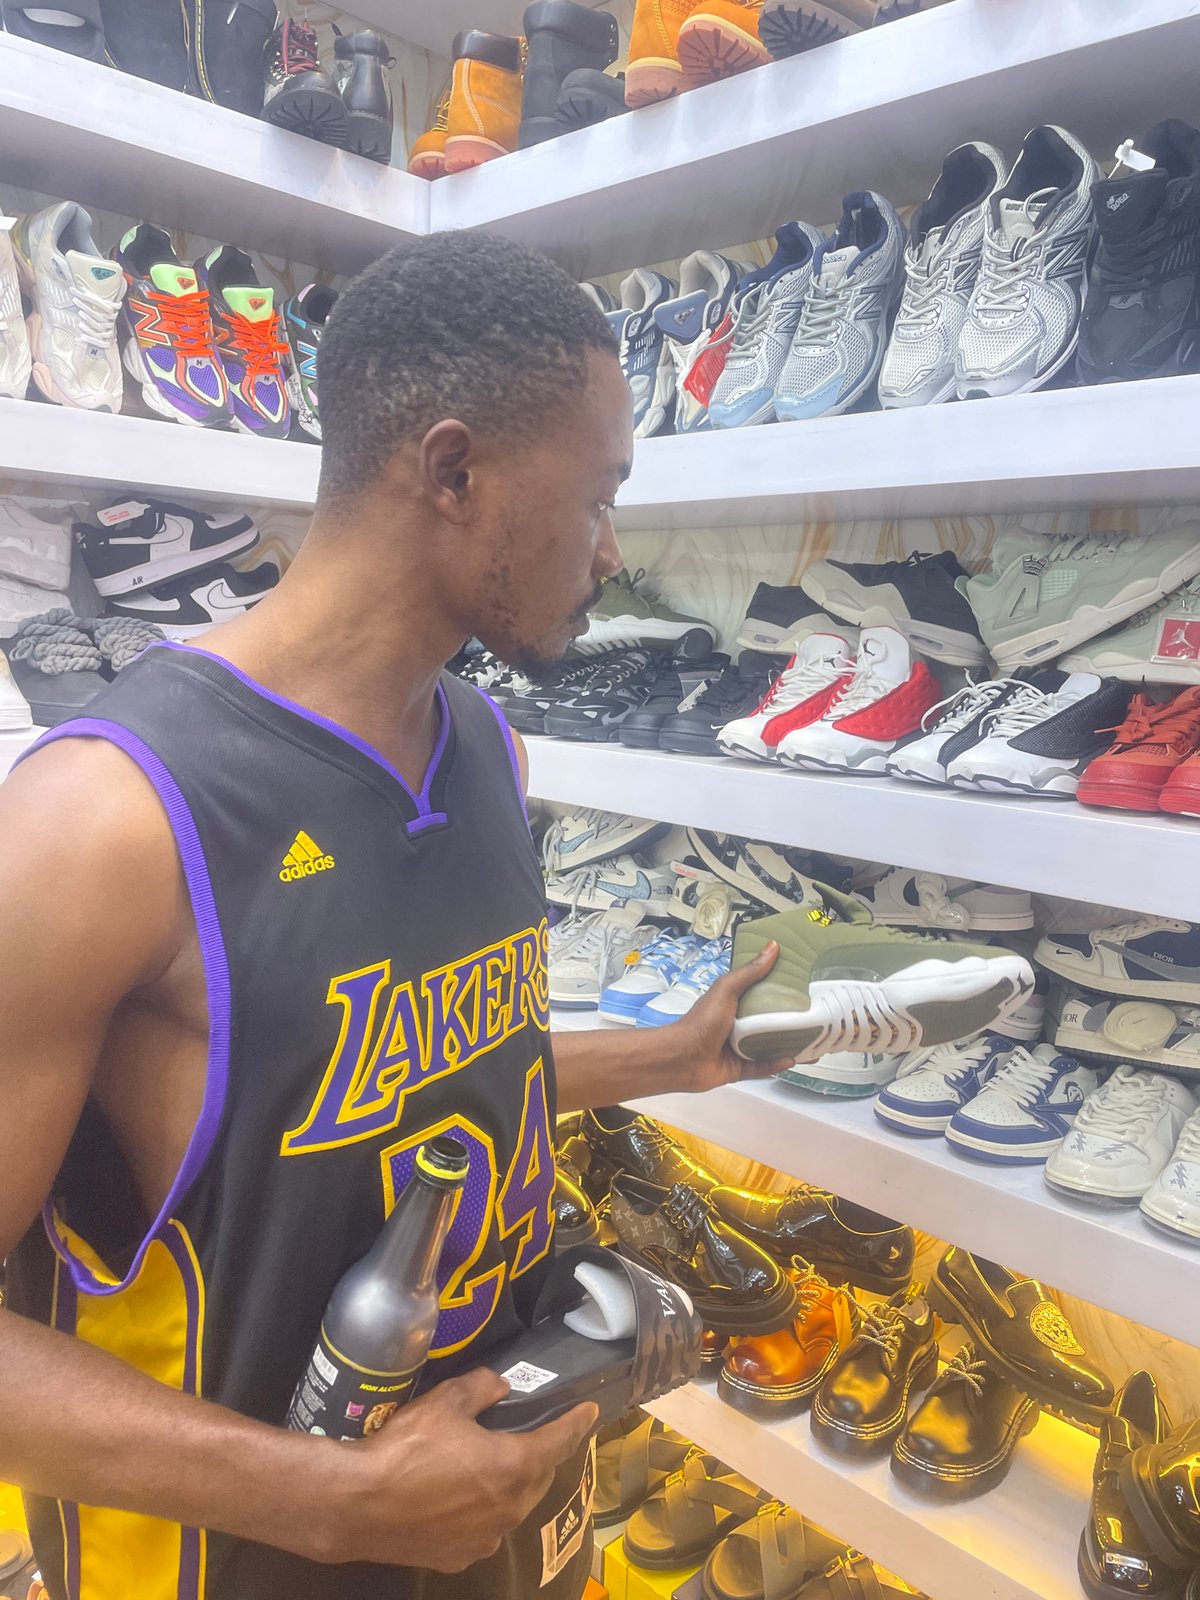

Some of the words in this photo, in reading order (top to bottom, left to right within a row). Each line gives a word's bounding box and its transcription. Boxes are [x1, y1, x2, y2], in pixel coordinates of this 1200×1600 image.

[132, 576, 144, 587] AIR
[279, 855, 335, 882] adidas
[1153, 951, 1175, 964] DIOR
[280, 917, 550, 1156] LAKERS
[380, 1055, 557, 1360] 24
